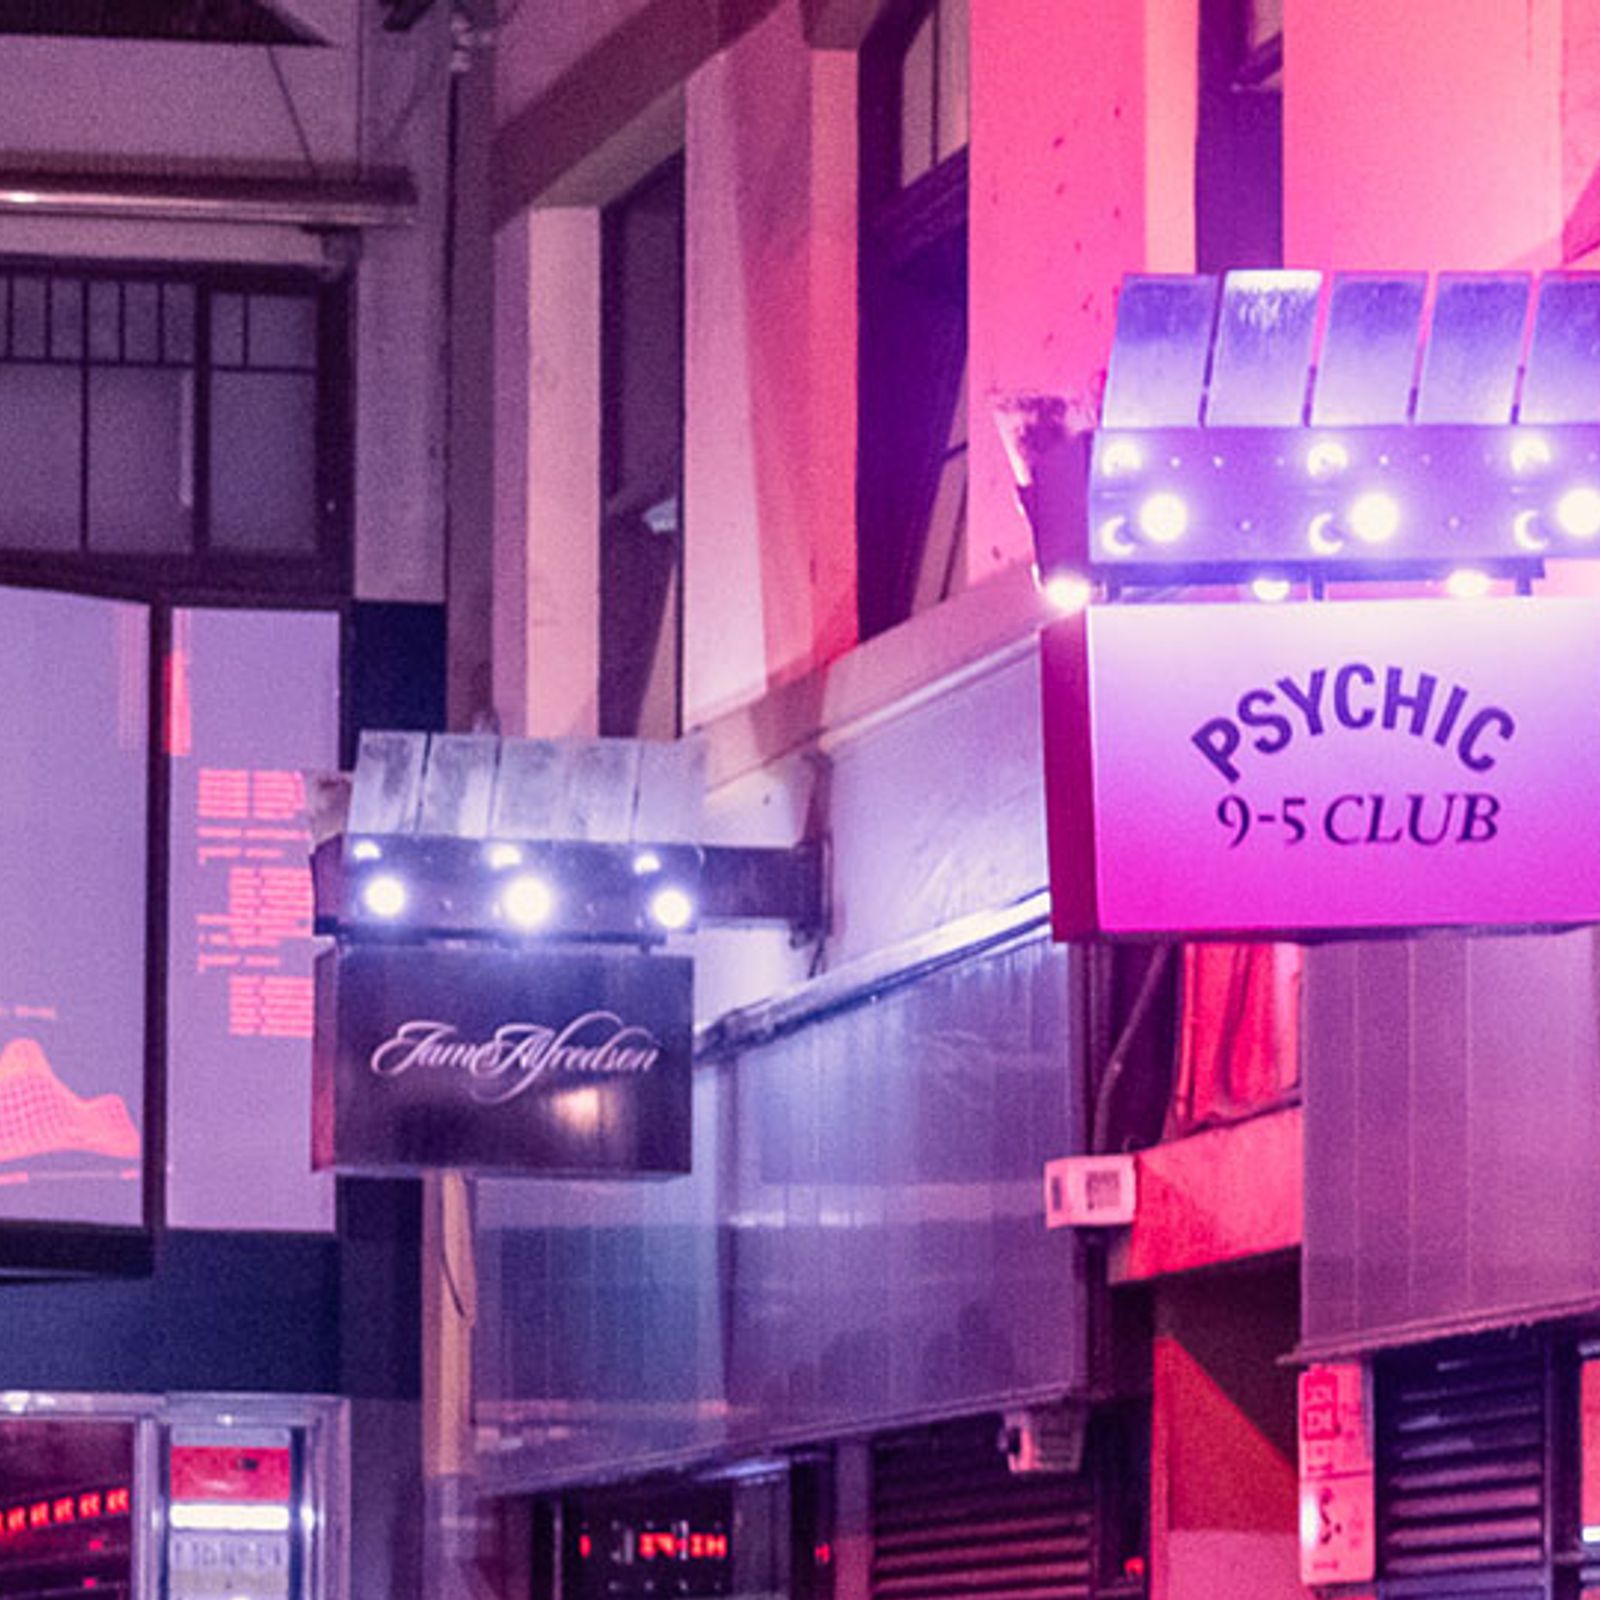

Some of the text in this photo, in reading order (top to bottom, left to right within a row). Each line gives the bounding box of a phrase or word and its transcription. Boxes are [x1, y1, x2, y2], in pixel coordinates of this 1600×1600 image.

[1191, 662, 1516, 784] PSYCHIC
[1216, 792, 1502, 850] 9-5 CLUB
